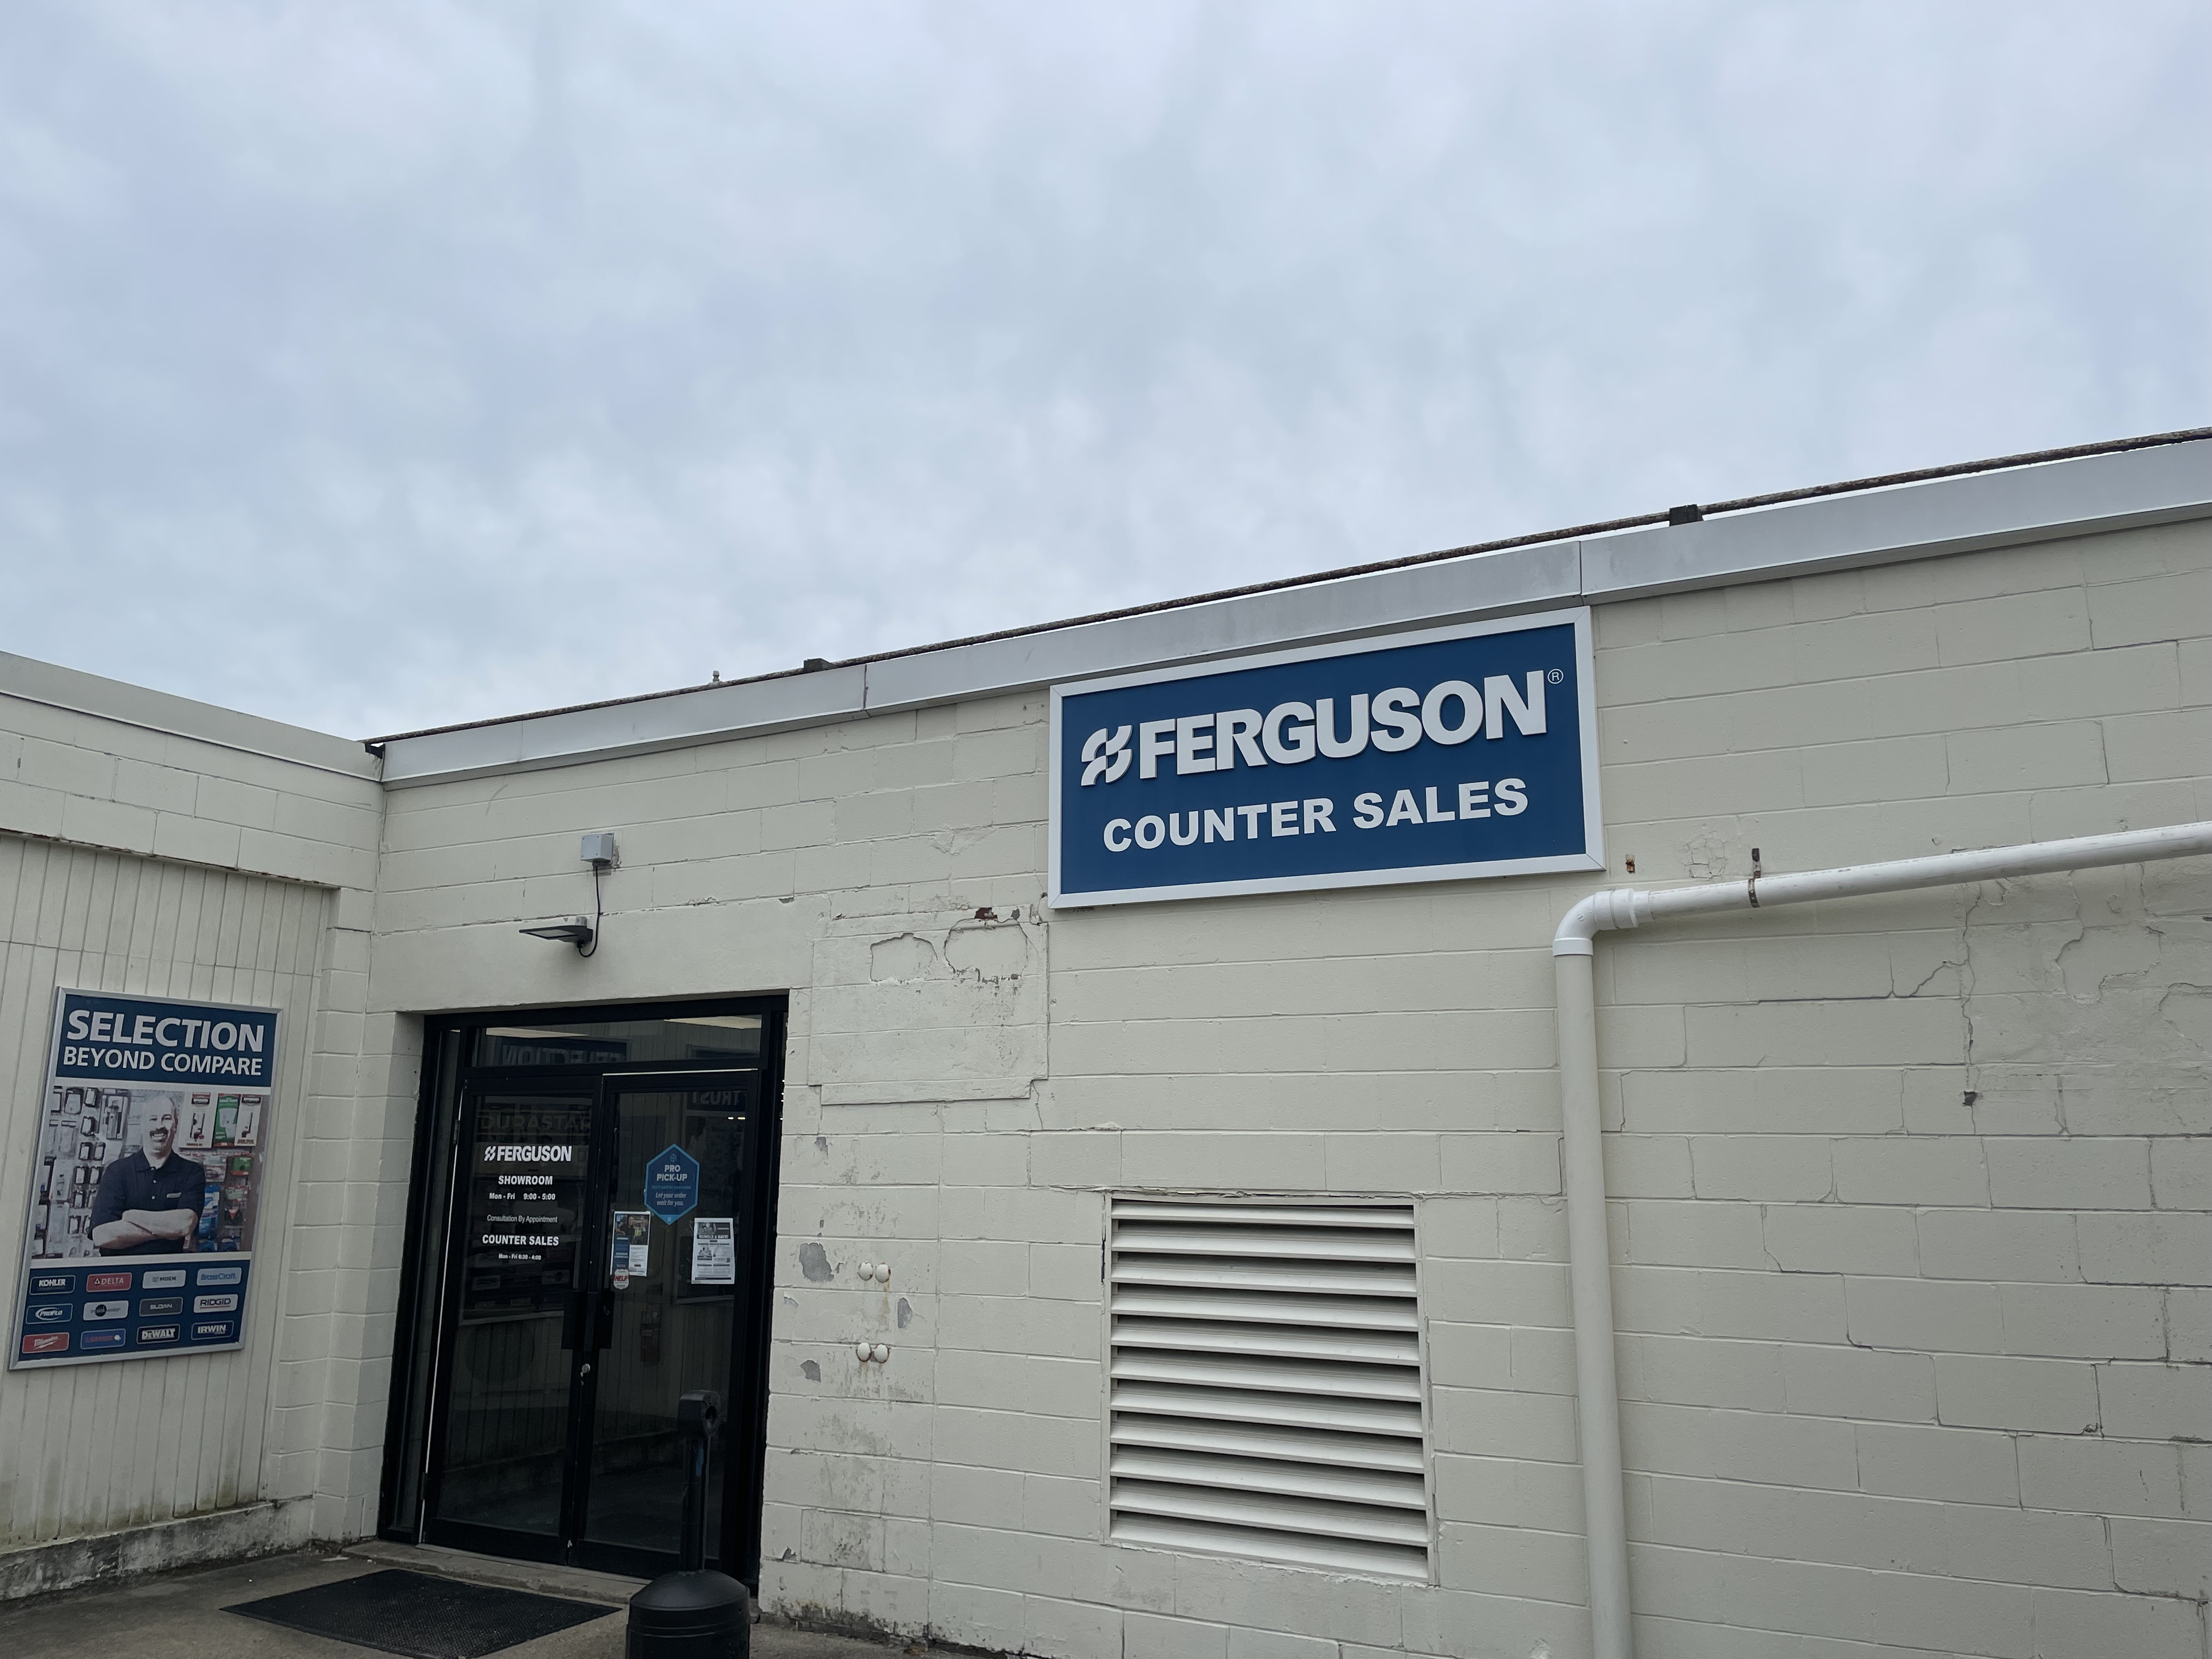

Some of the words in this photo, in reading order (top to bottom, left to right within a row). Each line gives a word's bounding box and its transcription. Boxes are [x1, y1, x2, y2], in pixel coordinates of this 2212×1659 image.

[1138, 669, 1547, 780] FERGUSON
[1103, 798, 1337, 853] COUNTER
[1353, 777, 1528, 830] SALES
[66, 1009, 264, 1053] SELECTION
[63, 1046, 155, 1070] BEYOND
[161, 1052, 263, 1076] COMPARE
[496, 1146, 572, 1162] FERGUSON
[498, 1175, 553, 1185] SHOWROOM
[656, 1173, 687, 1182] PICK-UP
[487, 1214, 517, 1222] Consultation
[526, 1216, 558, 1224] Appointment
[482, 1234, 527, 1245] COUNTER
[529, 1235, 559, 1246] SALES
[38, 1278, 66, 1287] KOHLER
[101, 1277, 125, 1285] DELTA
[200, 1298, 231, 1306] RIDGID
[197, 1324, 227, 1334] IRWIN
